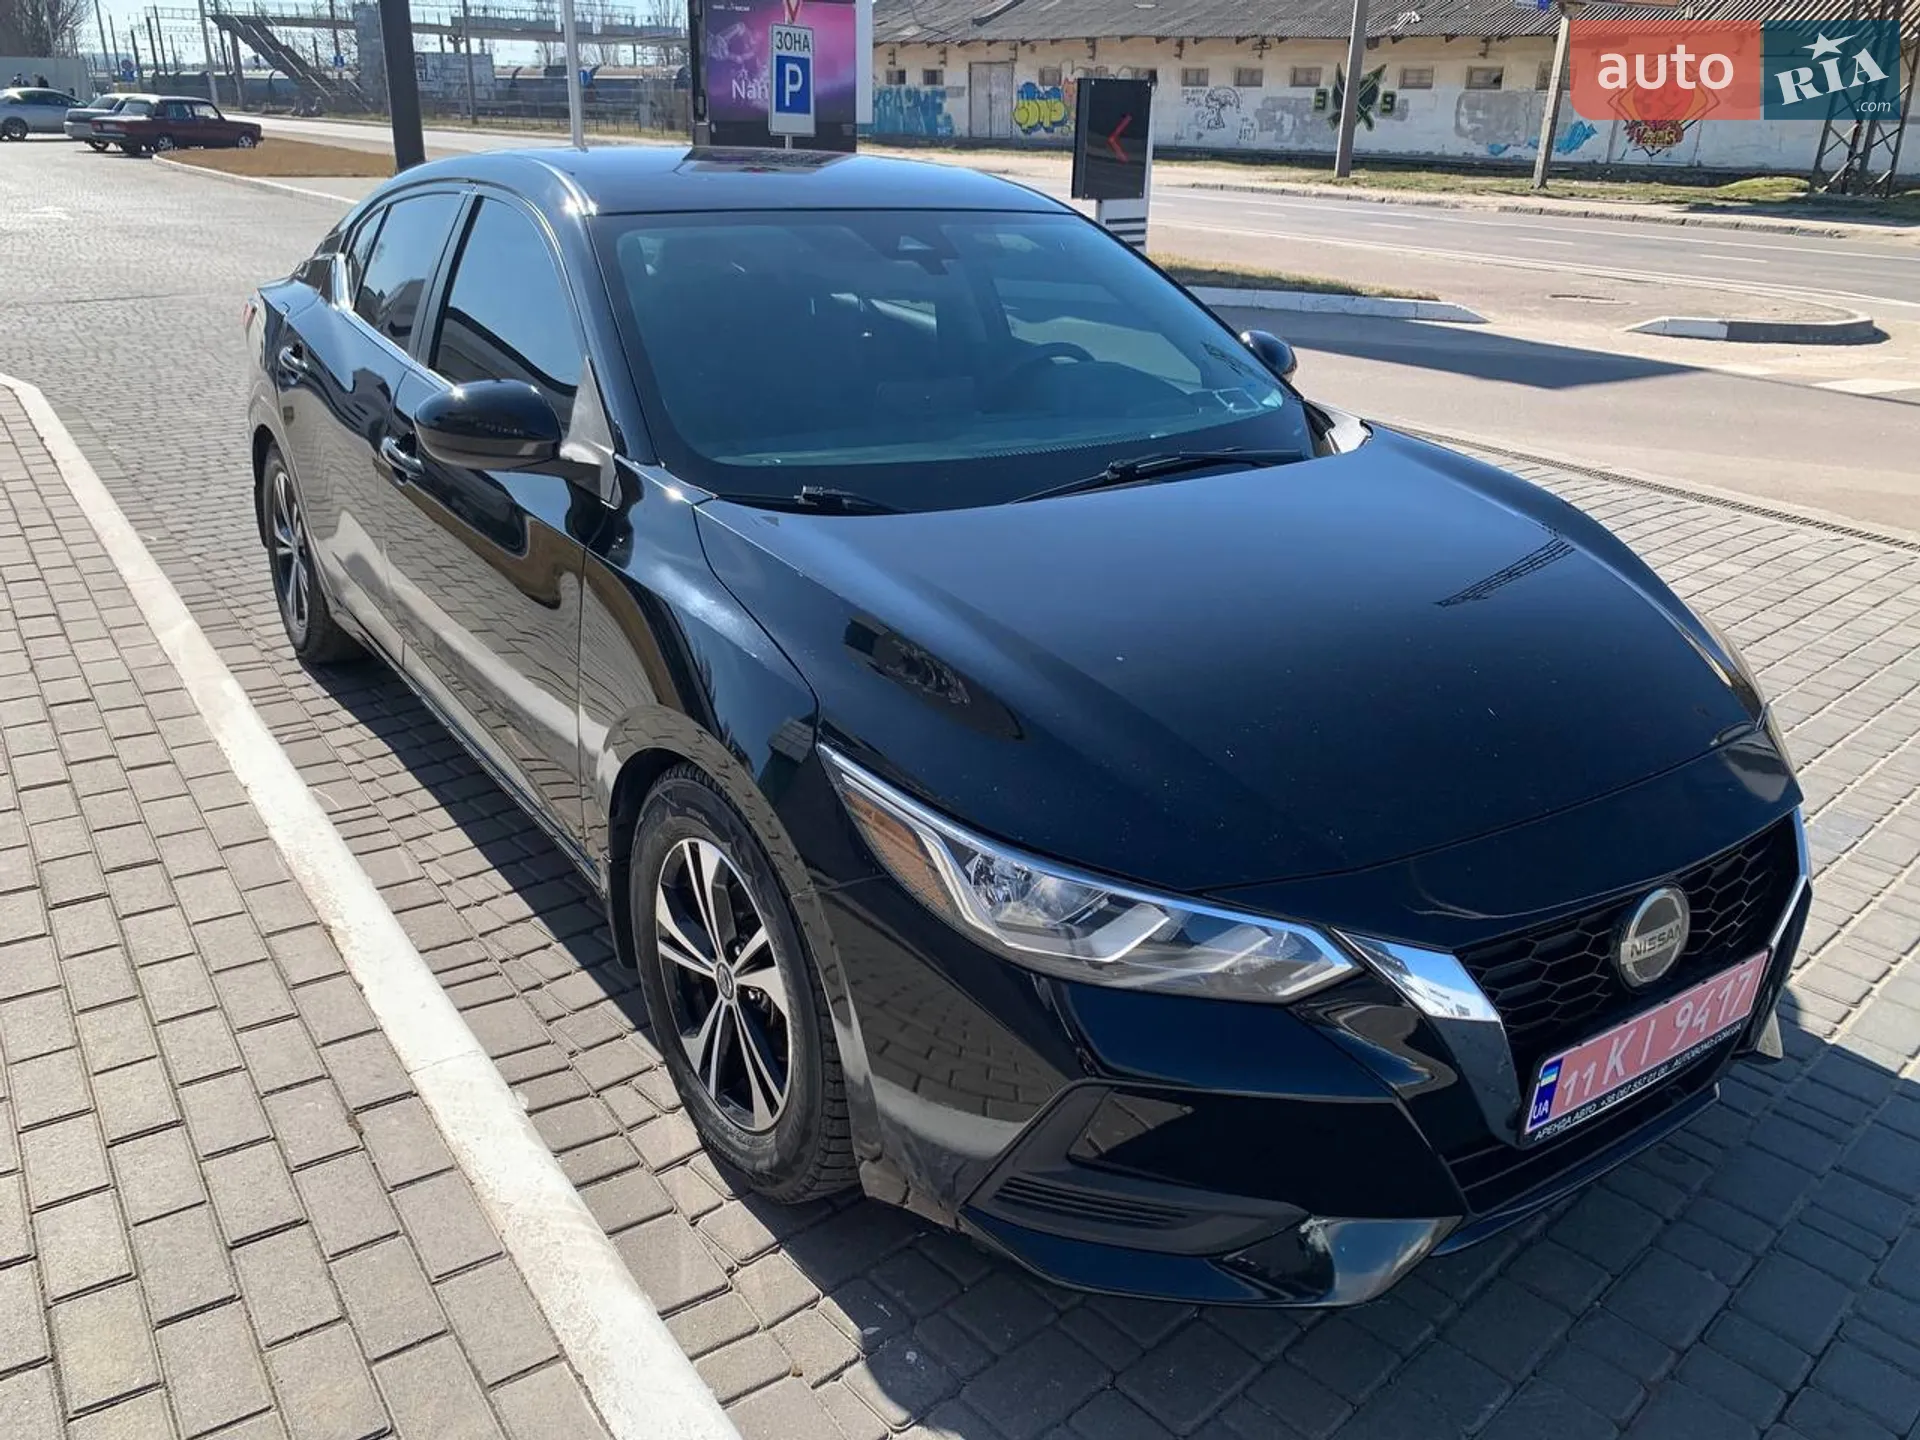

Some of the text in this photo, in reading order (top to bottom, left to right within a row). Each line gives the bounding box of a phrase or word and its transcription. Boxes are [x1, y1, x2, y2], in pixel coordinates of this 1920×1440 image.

[776, 31, 811, 52] ЗОНА
[785, 62, 803, 107] P
[1630, 924, 1681, 958] NISSAN
[1563, 1062, 1597, 1107] 11
[1668, 969, 1753, 1050] 9417
[1532, 1099, 1549, 1120] UA
